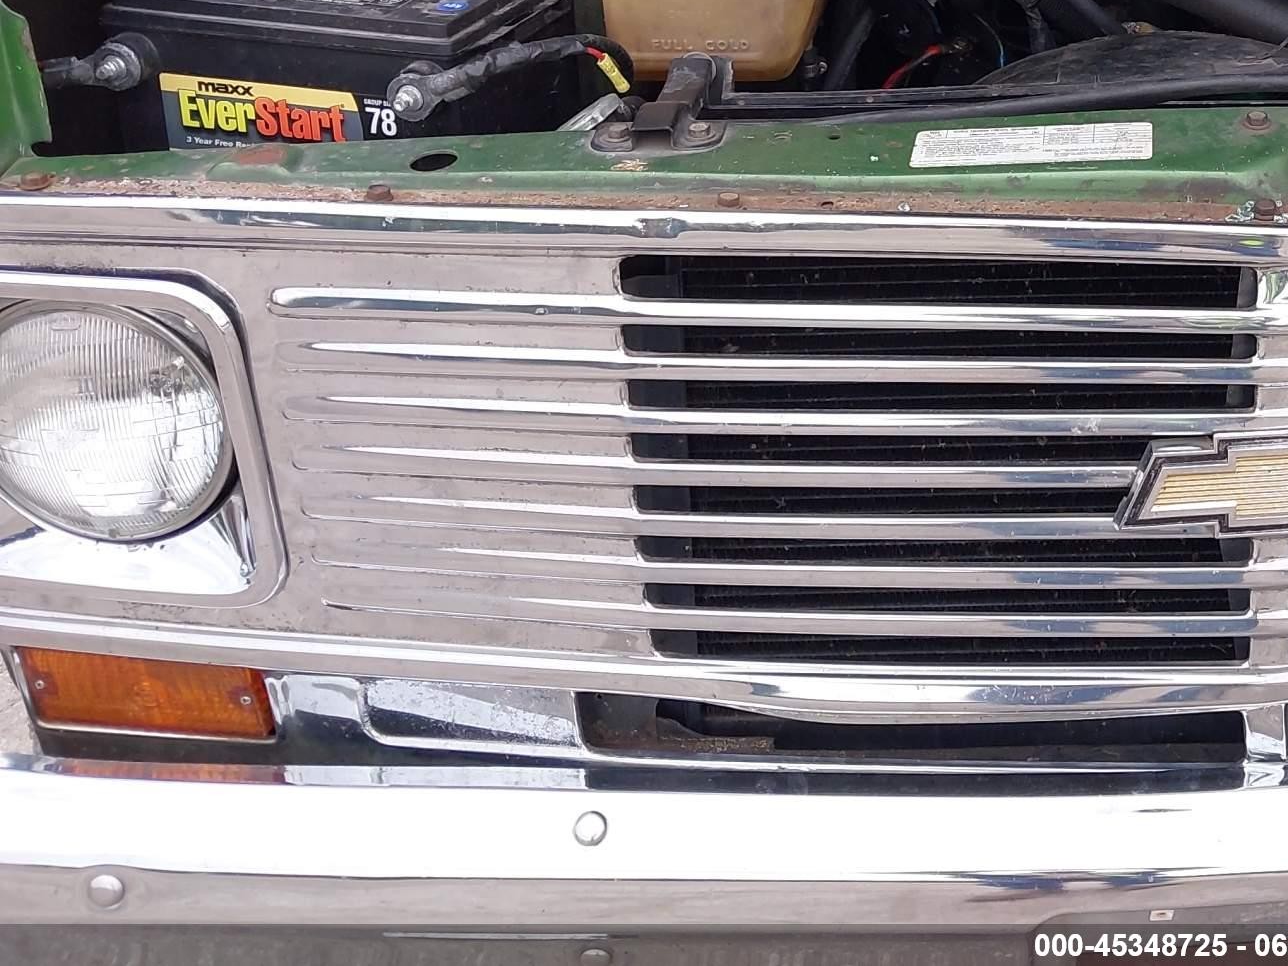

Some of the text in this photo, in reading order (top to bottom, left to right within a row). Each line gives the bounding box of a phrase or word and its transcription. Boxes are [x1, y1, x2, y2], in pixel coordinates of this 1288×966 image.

[650, 37, 750, 52] FULL COLD
[197, 81, 254, 97] maxx
[363, 98, 383, 107] GROUP
[177, 88, 345, 143] EverStart
[364, 106, 398, 136] 78
[193, 136, 214, 145] Year
[214, 138, 234, 147] Free
